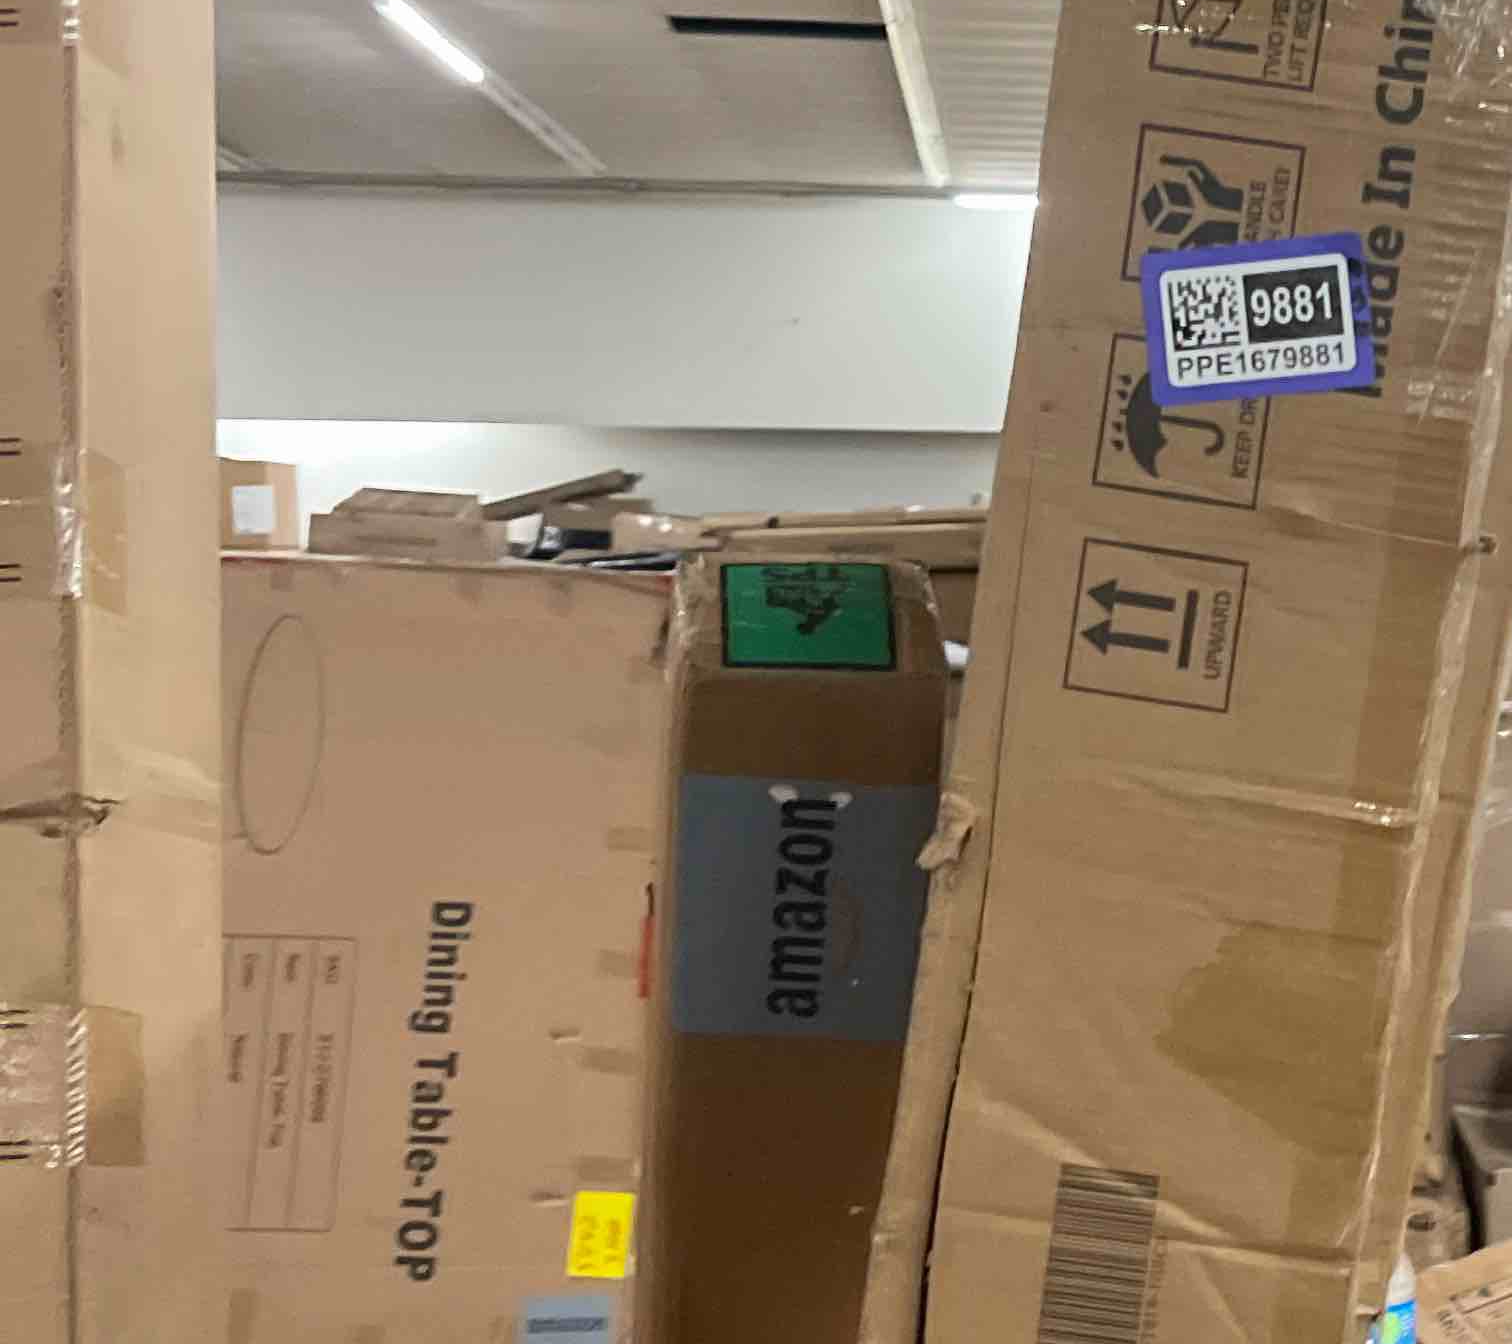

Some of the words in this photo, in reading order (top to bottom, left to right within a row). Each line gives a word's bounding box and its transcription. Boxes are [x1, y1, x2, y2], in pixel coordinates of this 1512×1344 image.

[1361, 144, 1416, 208] In
[1250, 281, 1333, 327] 9881
[1177, 341, 1345, 380] PPE1679881
[1239, 397, 1259, 425] DR
[1231, 431, 1255, 478] KEEP
[1203, 589, 1233, 681] UPWARD
[765, 798, 838, 1020] amazon
[408, 900, 475, 1034] Dining
[395, 1051, 460, 1283] Table-TOP
